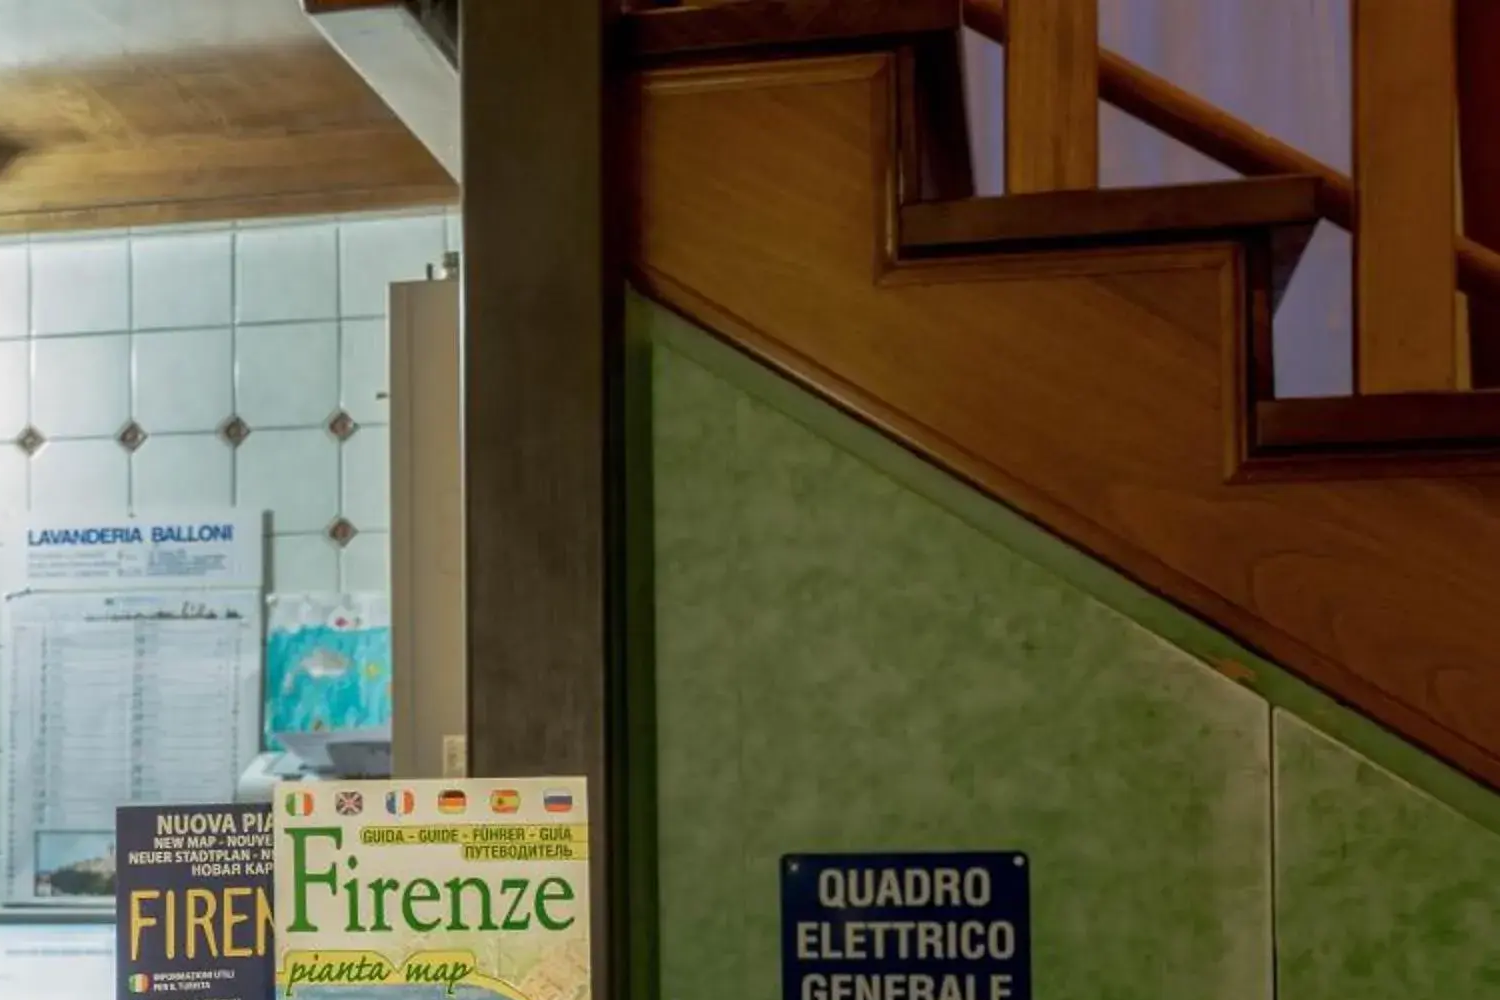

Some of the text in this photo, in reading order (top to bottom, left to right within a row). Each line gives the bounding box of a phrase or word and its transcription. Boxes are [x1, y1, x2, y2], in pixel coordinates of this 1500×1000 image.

[27, 524, 235, 547] LAVANDERIA BALLONI
[156, 813, 236, 835] NUOVA
[153, 836, 185, 849] NEW
[187, 836, 217, 848] MAP
[362, 829, 405, 843] GUIDA
[419, 828, 460, 843] GUIDE
[128, 851, 172, 865] NEUER
[175, 849, 251, 863] STADTPLAN
[464, 845, 574, 860] ПУТЕВОДИТЕЛЬ
[284, 827, 576, 933] Firenze
[818, 867, 991, 909] QUADRO
[797, 920, 1015, 960] ELETTRICO
[285, 955, 472, 996] pianta map
